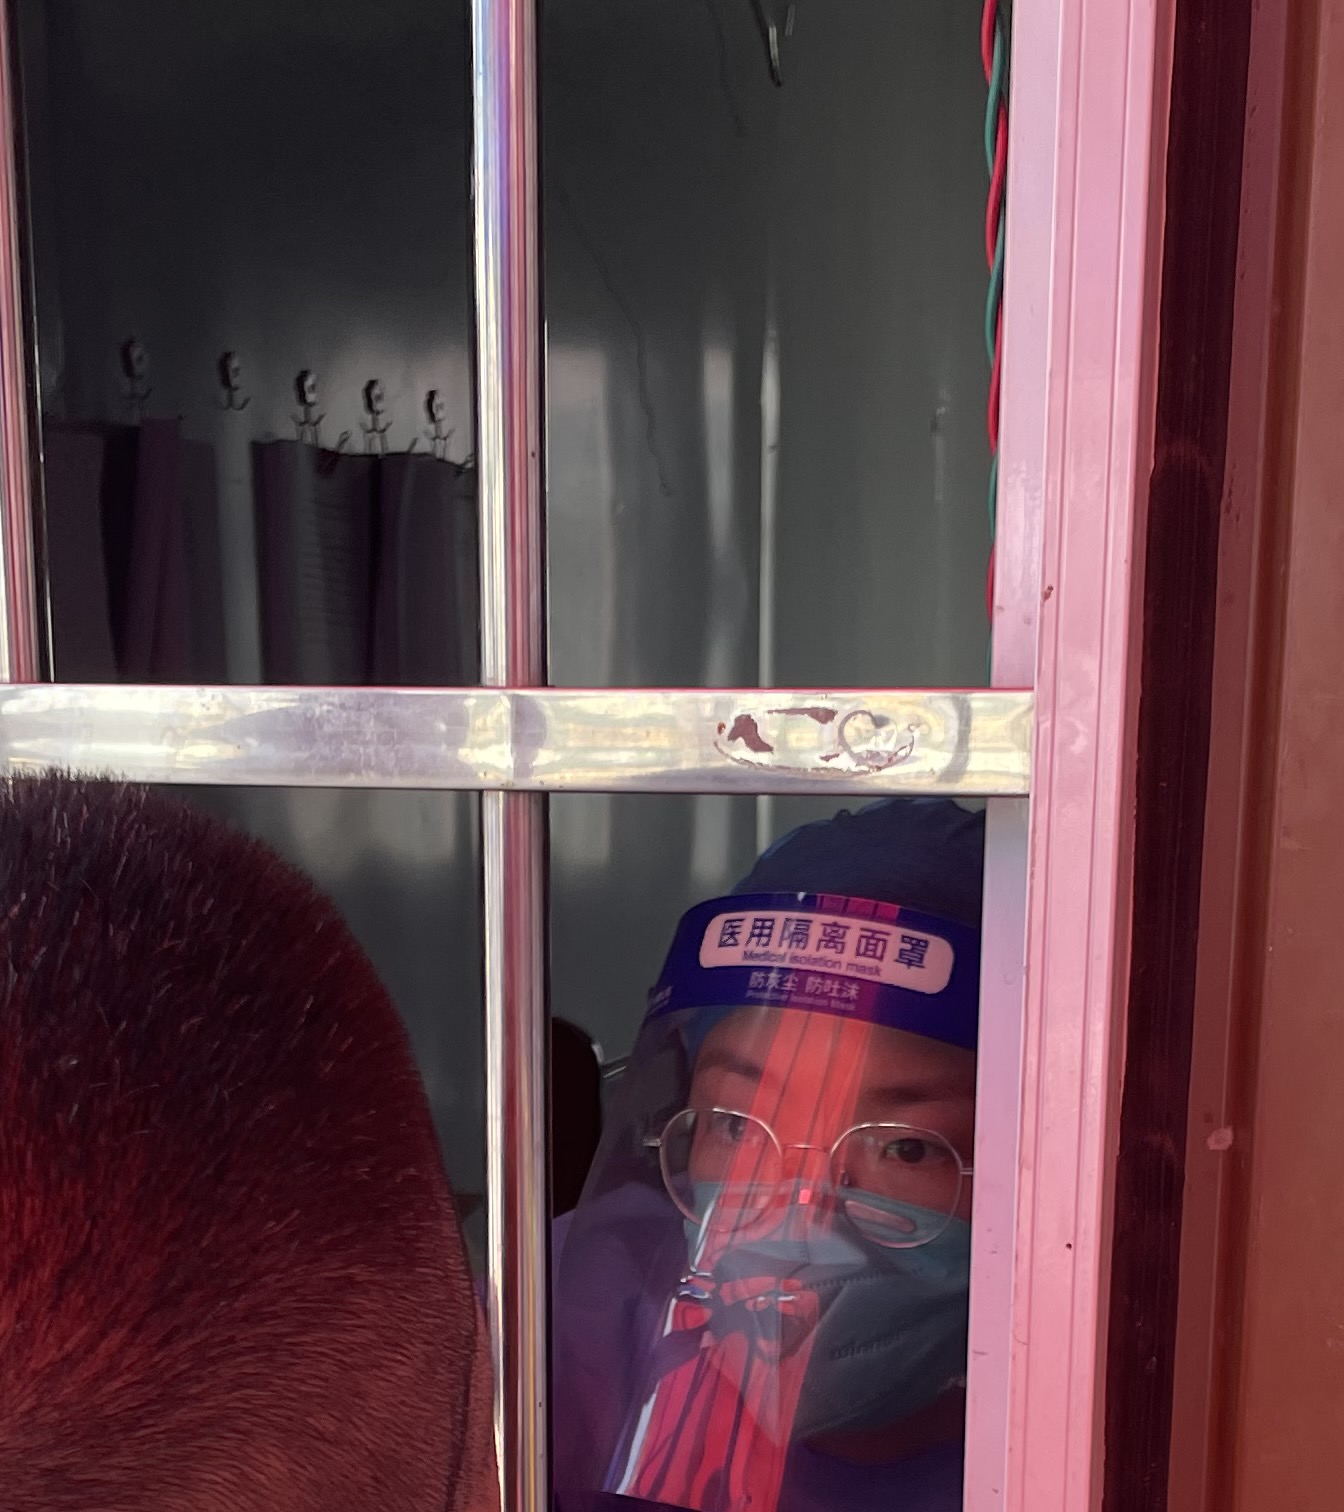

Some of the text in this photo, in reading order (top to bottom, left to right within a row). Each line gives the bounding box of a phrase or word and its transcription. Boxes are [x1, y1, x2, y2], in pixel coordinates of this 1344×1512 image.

[717, 917, 931, 971] 医用隔离面罩
